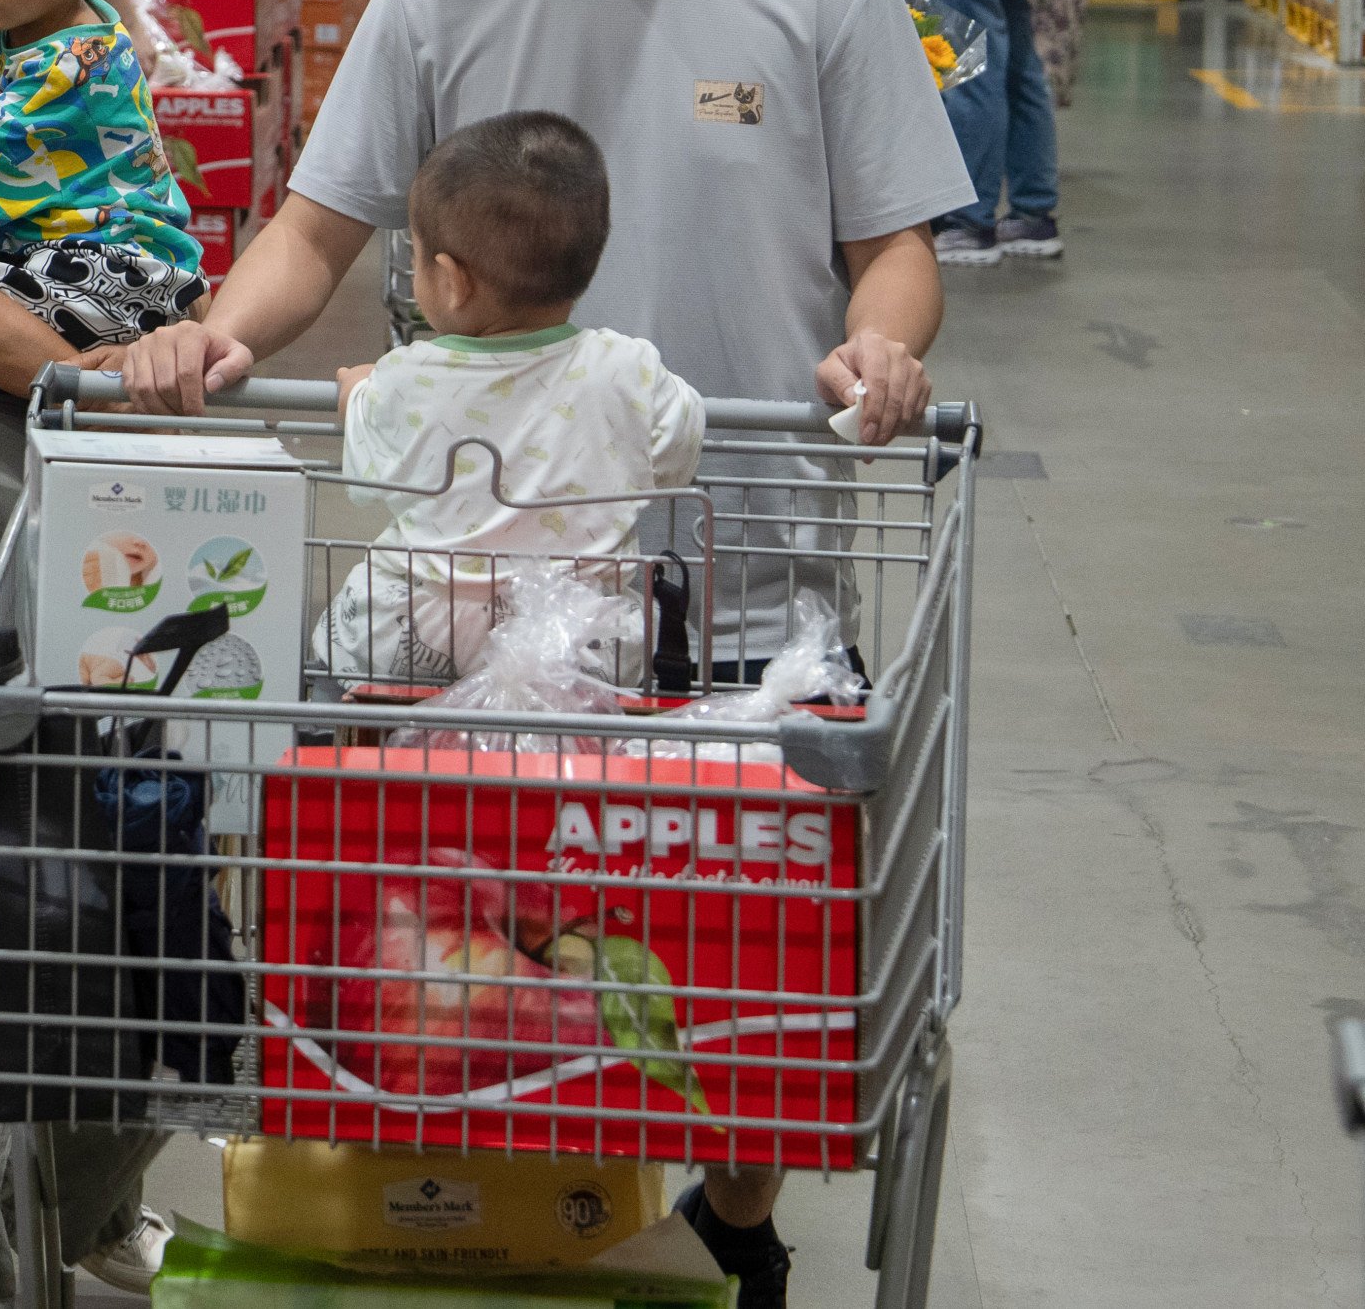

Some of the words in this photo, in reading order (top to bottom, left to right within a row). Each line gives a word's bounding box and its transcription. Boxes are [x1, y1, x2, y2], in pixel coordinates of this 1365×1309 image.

[156, 96, 244, 116] APPLES
[164, 486, 267, 514] 婴儿湿巾
[544, 801, 834, 866] APPLES
[388, 1201, 442, 1212] Member's
[443, 1201, 473, 1212] Mark
[420, 1247, 509, 1261] SKIN-FRIENDLY
